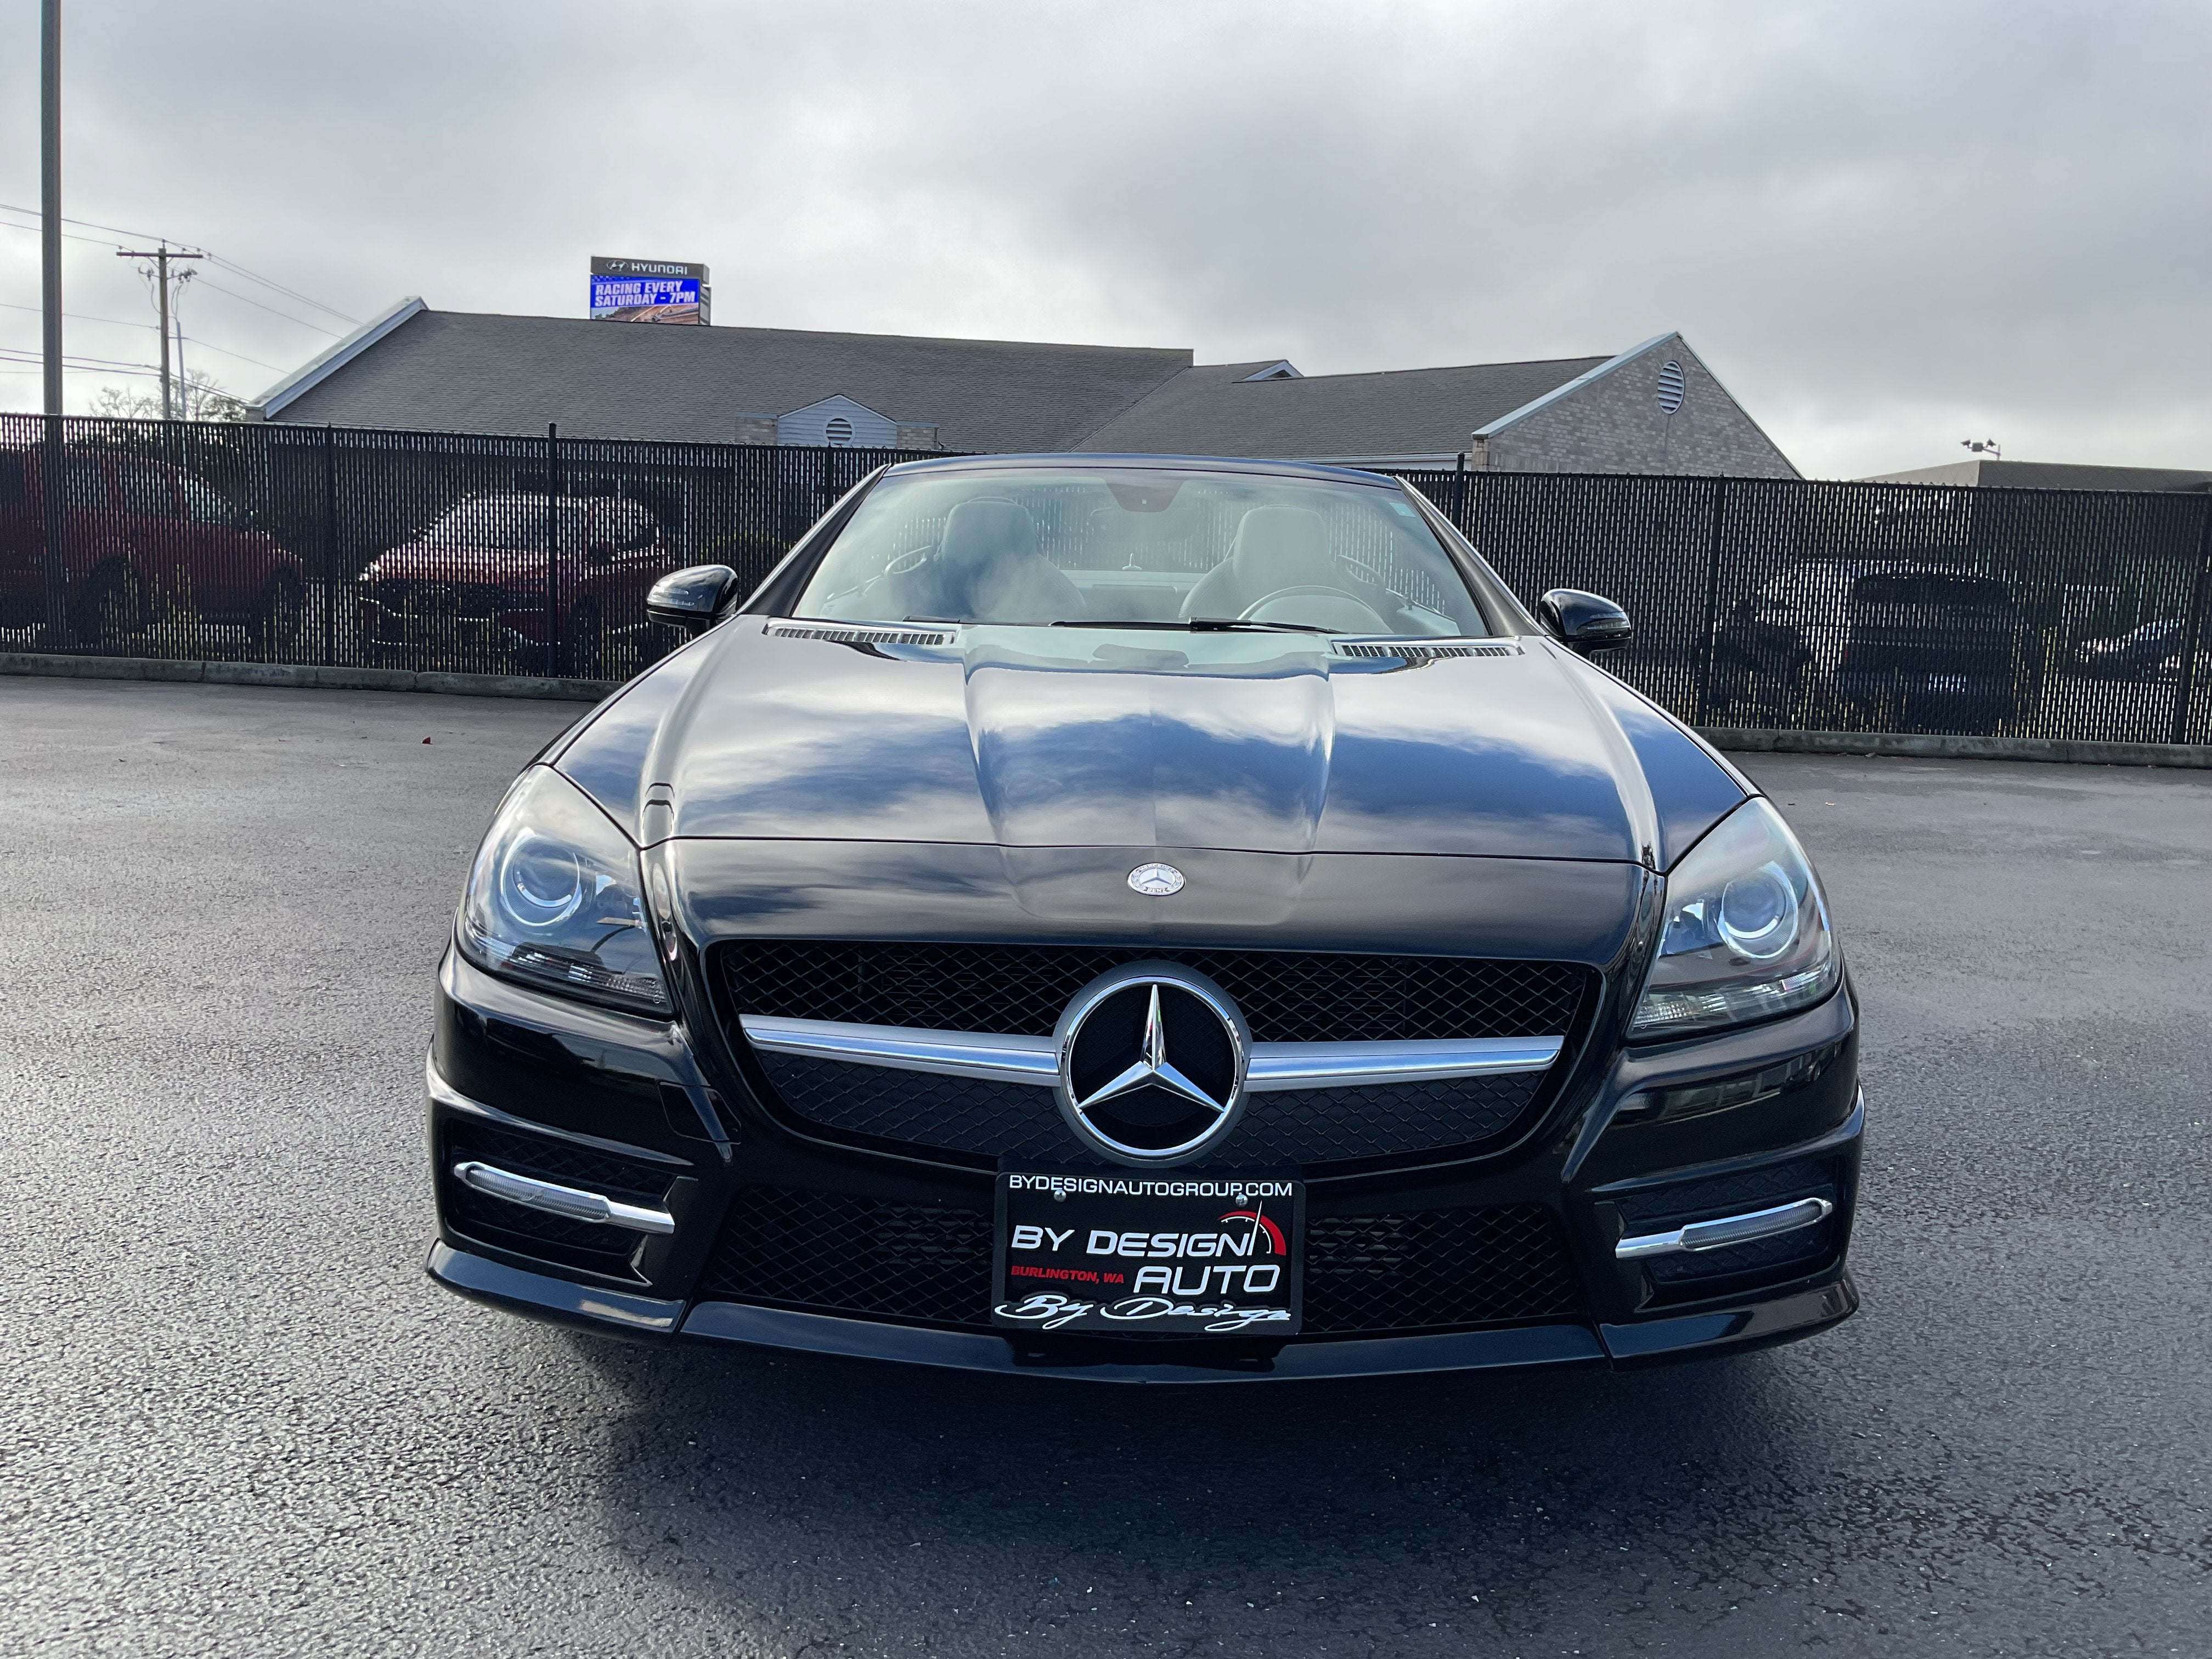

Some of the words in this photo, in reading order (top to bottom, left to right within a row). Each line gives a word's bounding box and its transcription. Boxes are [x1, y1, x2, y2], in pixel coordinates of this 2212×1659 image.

[631, 263, 687, 275] HYUNDAI
[596, 283, 641, 295] RACING
[645, 281, 683, 293] EVERY
[595, 294, 657, 307] SATURDAY
[669, 291, 696, 303] 7PM
[1009, 1175, 1293, 1196] BYDESIGNAUTOGROUP.COM
[1011, 1225, 1075, 1251] BY
[1086, 1229, 1251, 1258] DESIGN
[1011, 1266, 1099, 1284] BURLINGTON,
[1103, 1273, 1125, 1284] WA
[1133, 1264, 1280, 1296] AUTO
[994, 1295, 1093, 1330] By
[1099, 1297, 1291, 1331] Design
